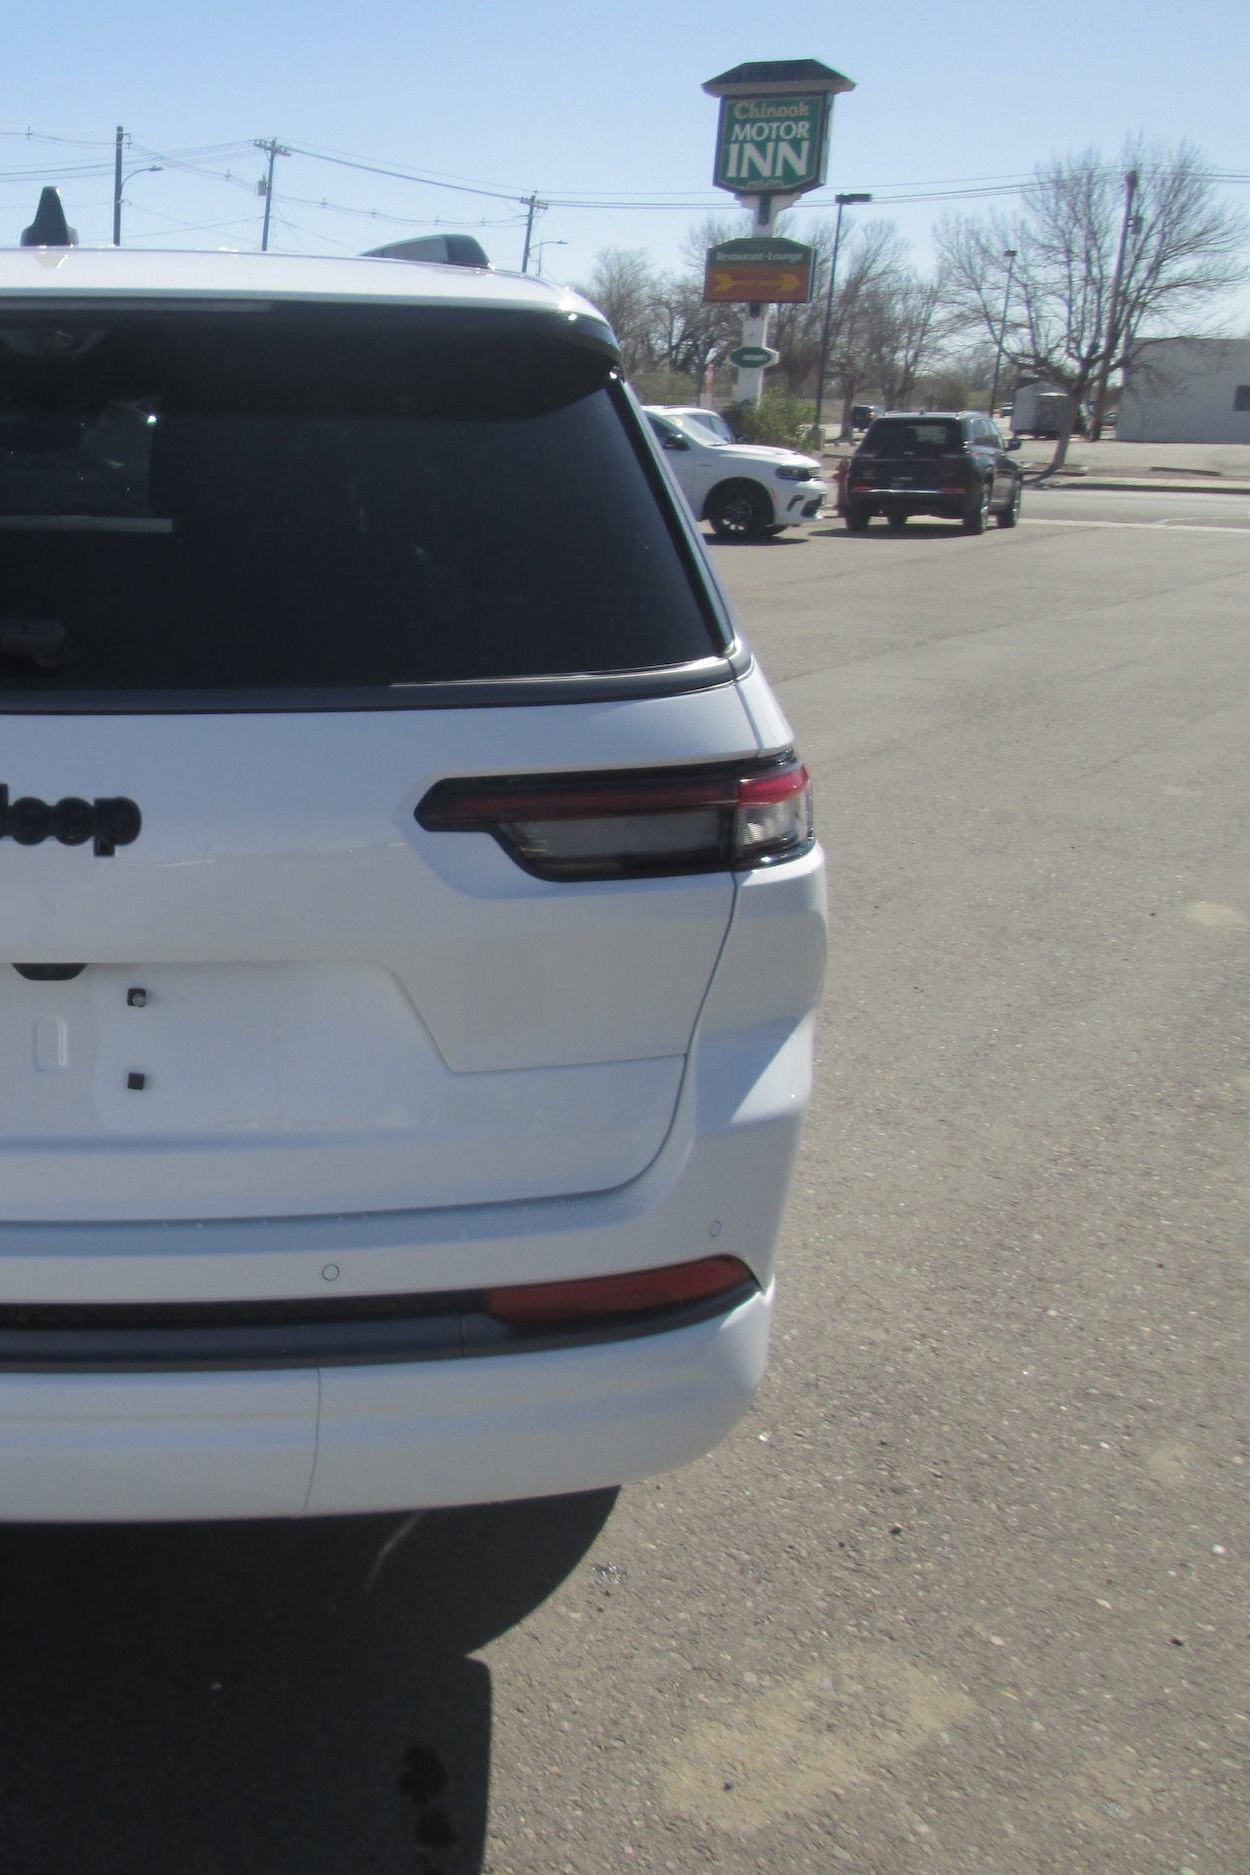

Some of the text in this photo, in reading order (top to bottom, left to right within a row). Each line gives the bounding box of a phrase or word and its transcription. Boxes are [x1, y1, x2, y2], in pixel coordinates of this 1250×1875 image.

[734, 101, 810, 119] Chinook
[732, 121, 810, 141] MOTOR
[726, 141, 810, 178] INN
